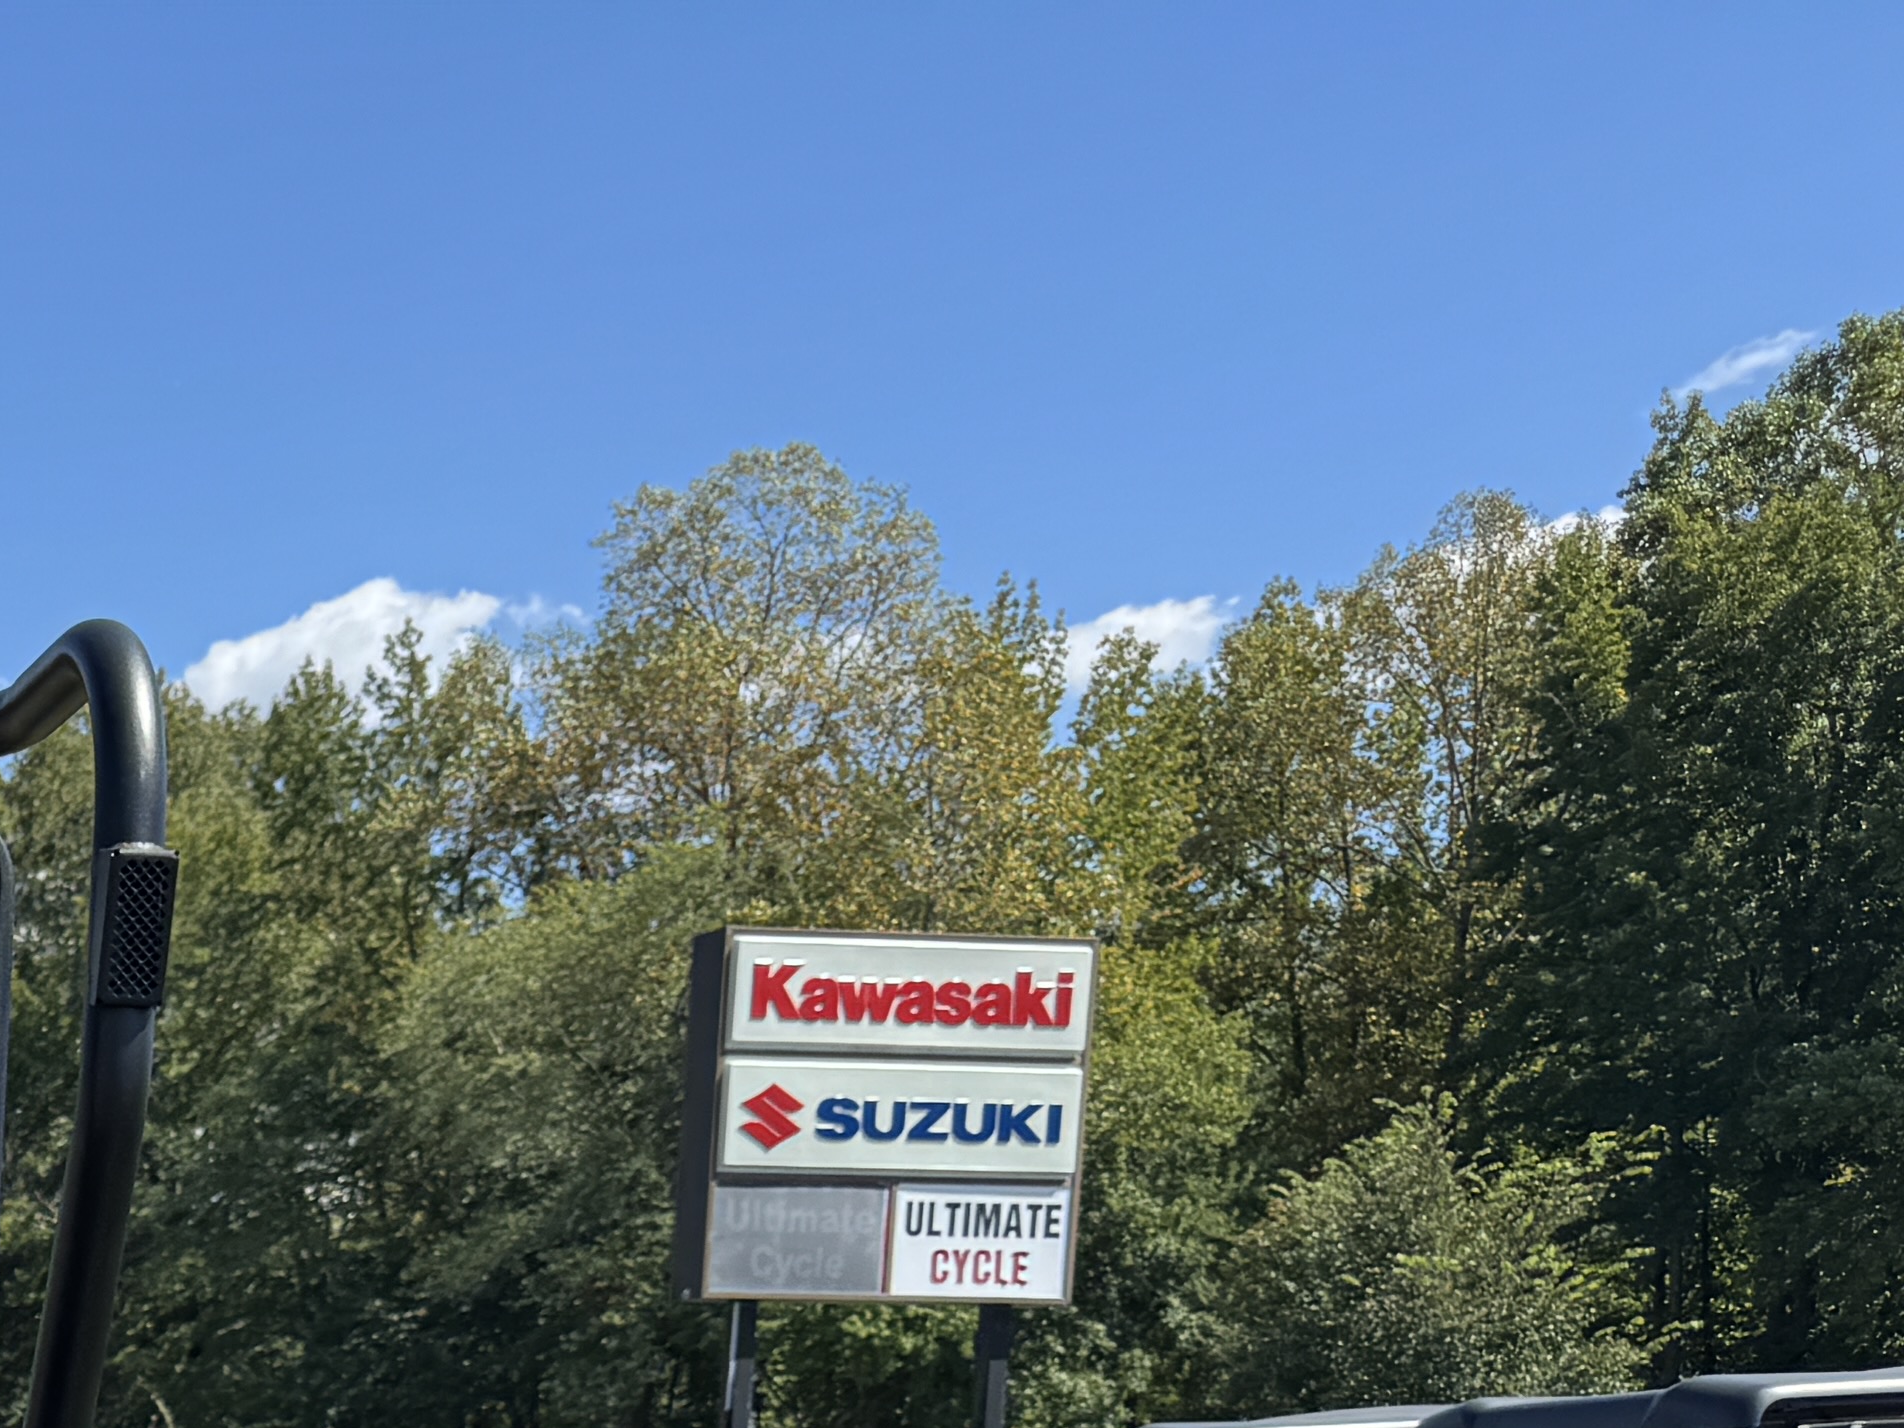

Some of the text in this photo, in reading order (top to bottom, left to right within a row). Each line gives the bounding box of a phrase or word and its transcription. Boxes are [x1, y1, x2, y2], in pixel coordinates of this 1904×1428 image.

[749, 956, 1076, 1029] Kawasaki
[815, 1094, 1064, 1145] SUZUKI
[725, 1197, 877, 1234] Ultimate
[905, 1201, 1062, 1239] ULTIMATE
[750, 1244, 844, 1285] Cycle
[929, 1249, 1030, 1286] CYCLE
